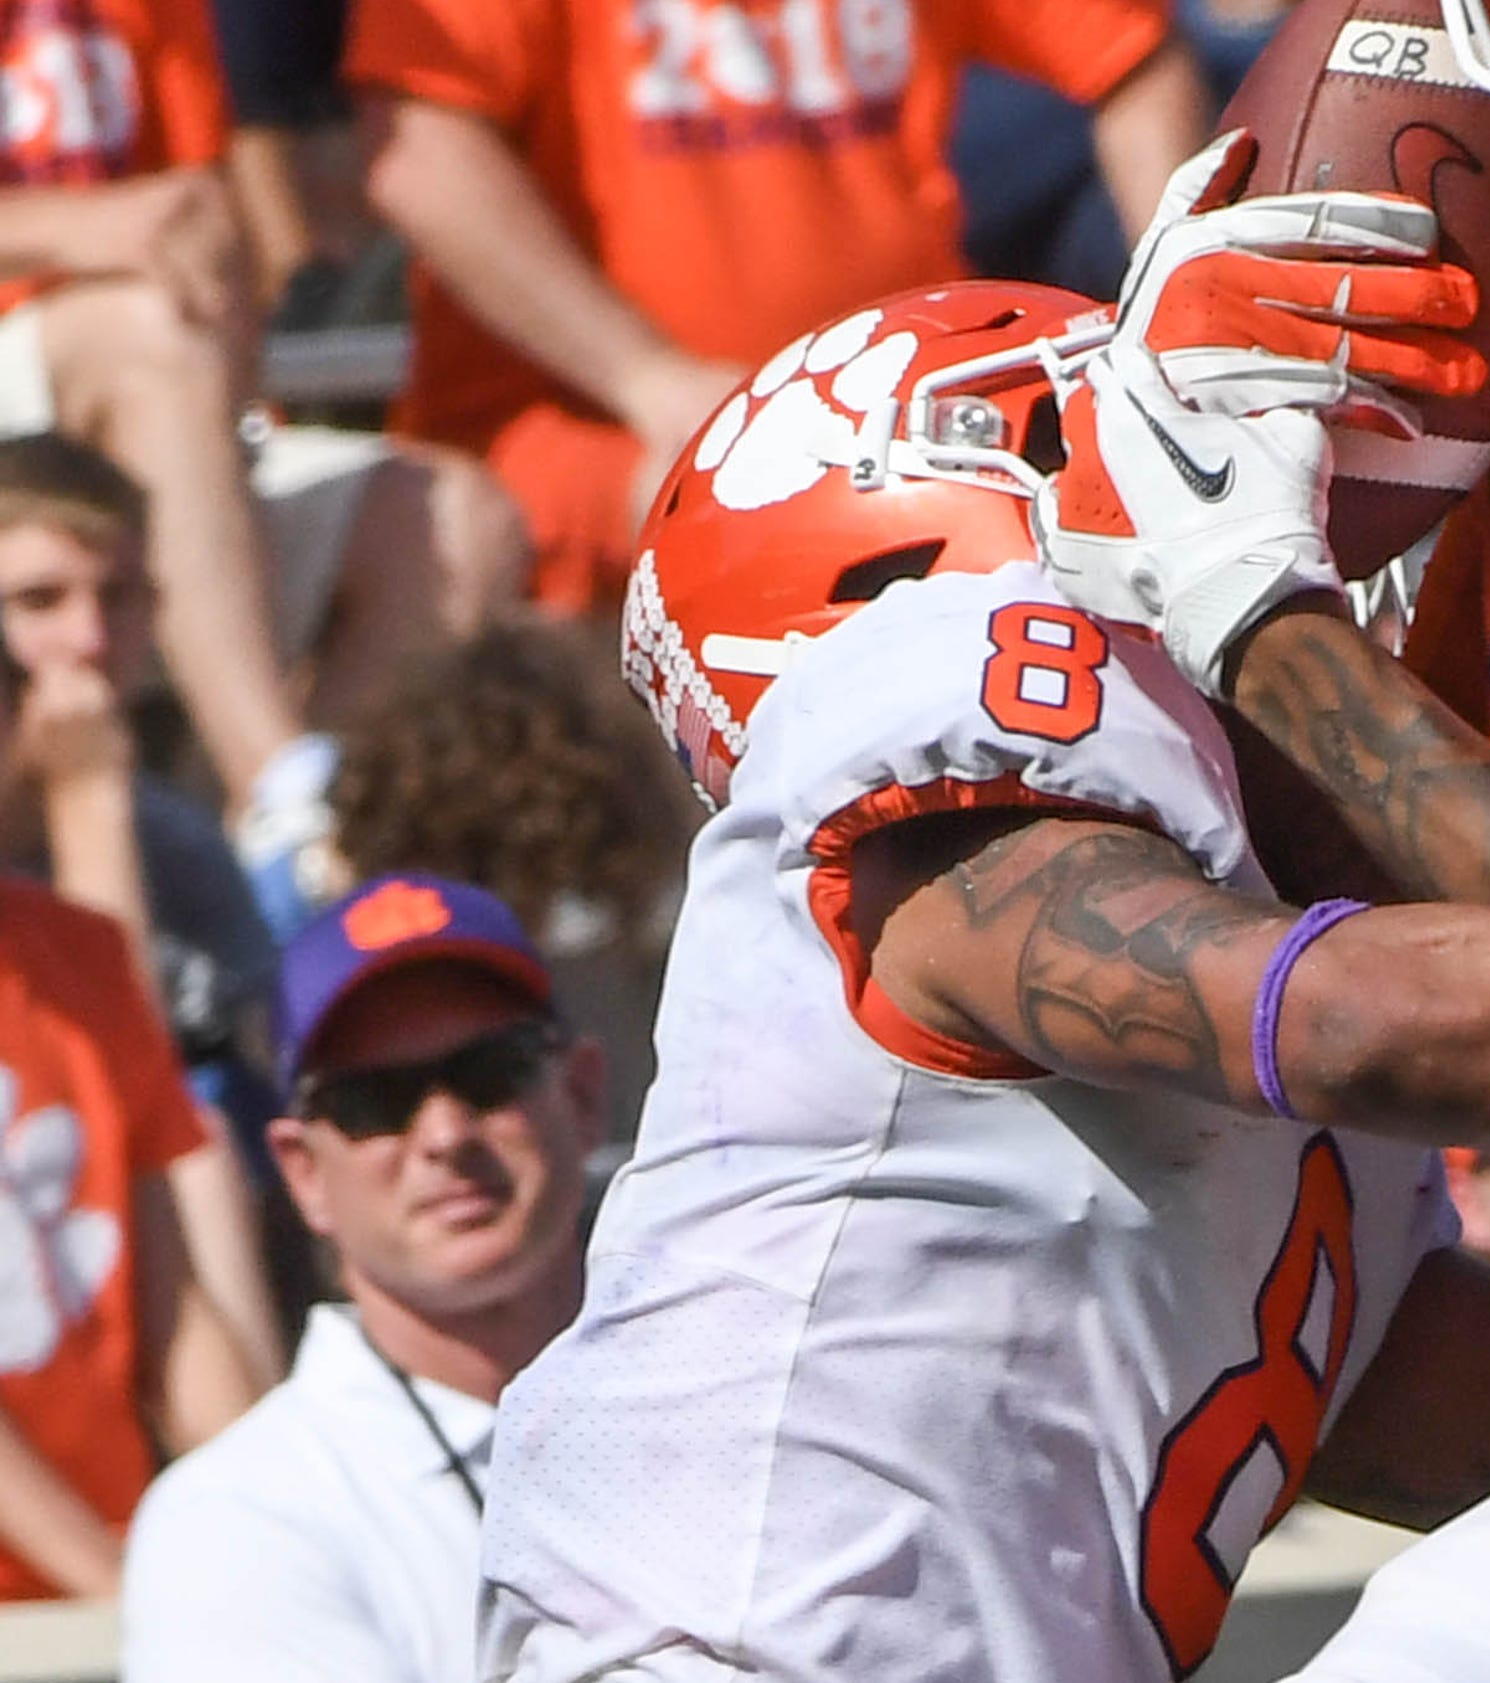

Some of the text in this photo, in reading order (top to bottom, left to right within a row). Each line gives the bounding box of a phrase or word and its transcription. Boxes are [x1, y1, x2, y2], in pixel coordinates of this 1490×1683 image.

[1348, 30, 1429, 79] QB
[980, 601, 1109, 745] 8
[1139, 1127, 1357, 1683] 8
